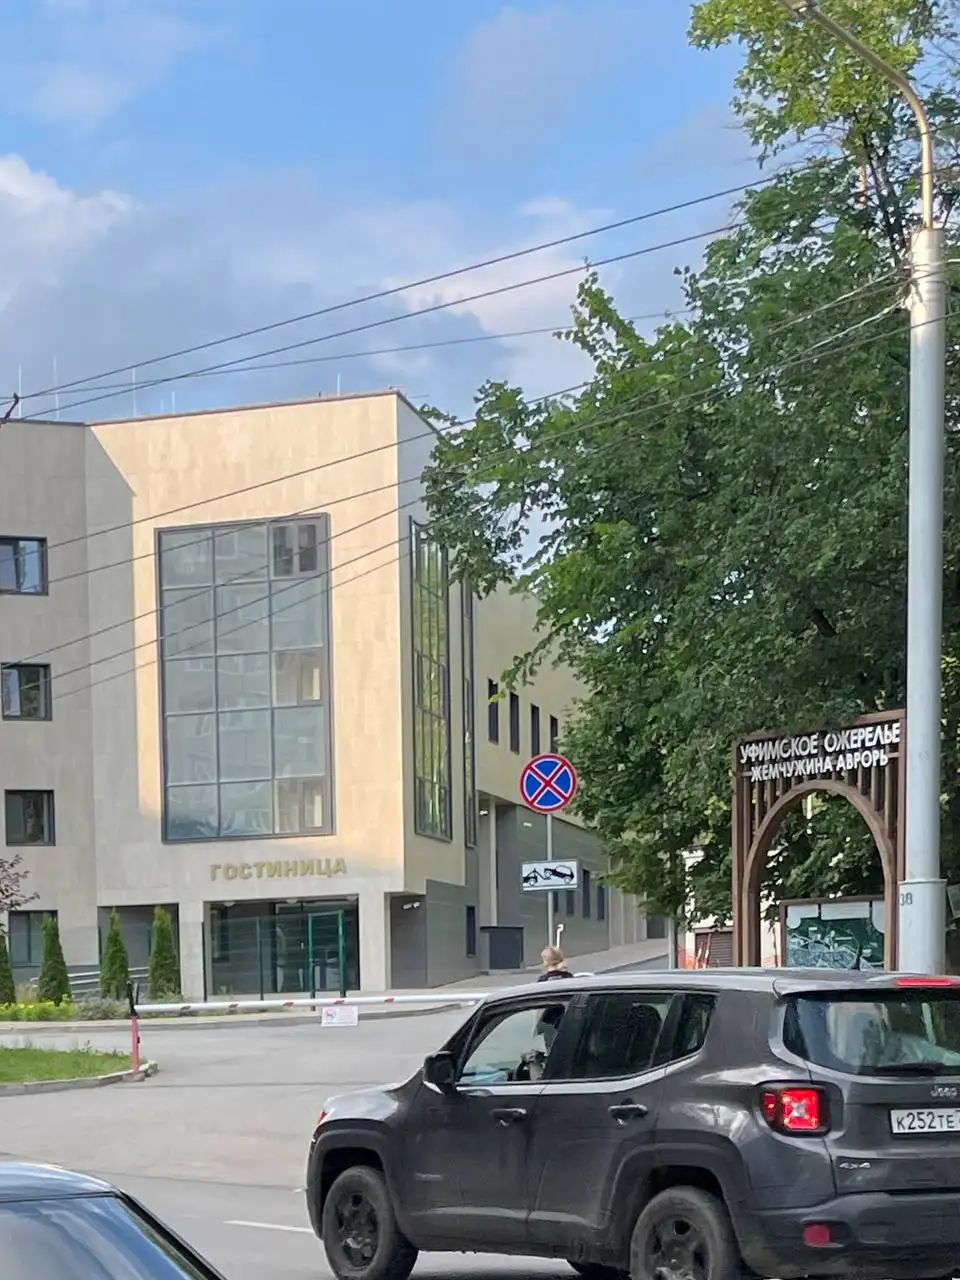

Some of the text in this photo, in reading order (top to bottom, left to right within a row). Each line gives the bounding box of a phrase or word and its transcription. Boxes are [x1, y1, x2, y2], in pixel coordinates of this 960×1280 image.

[740, 722, 901, 764] УФИМСКОЕ ОЖЕРЕЛЬЕ
[750, 755, 833, 782] ЖЕМЧУЖИНА
[209, 857, 347, 881] ГОСТИНИЦА
